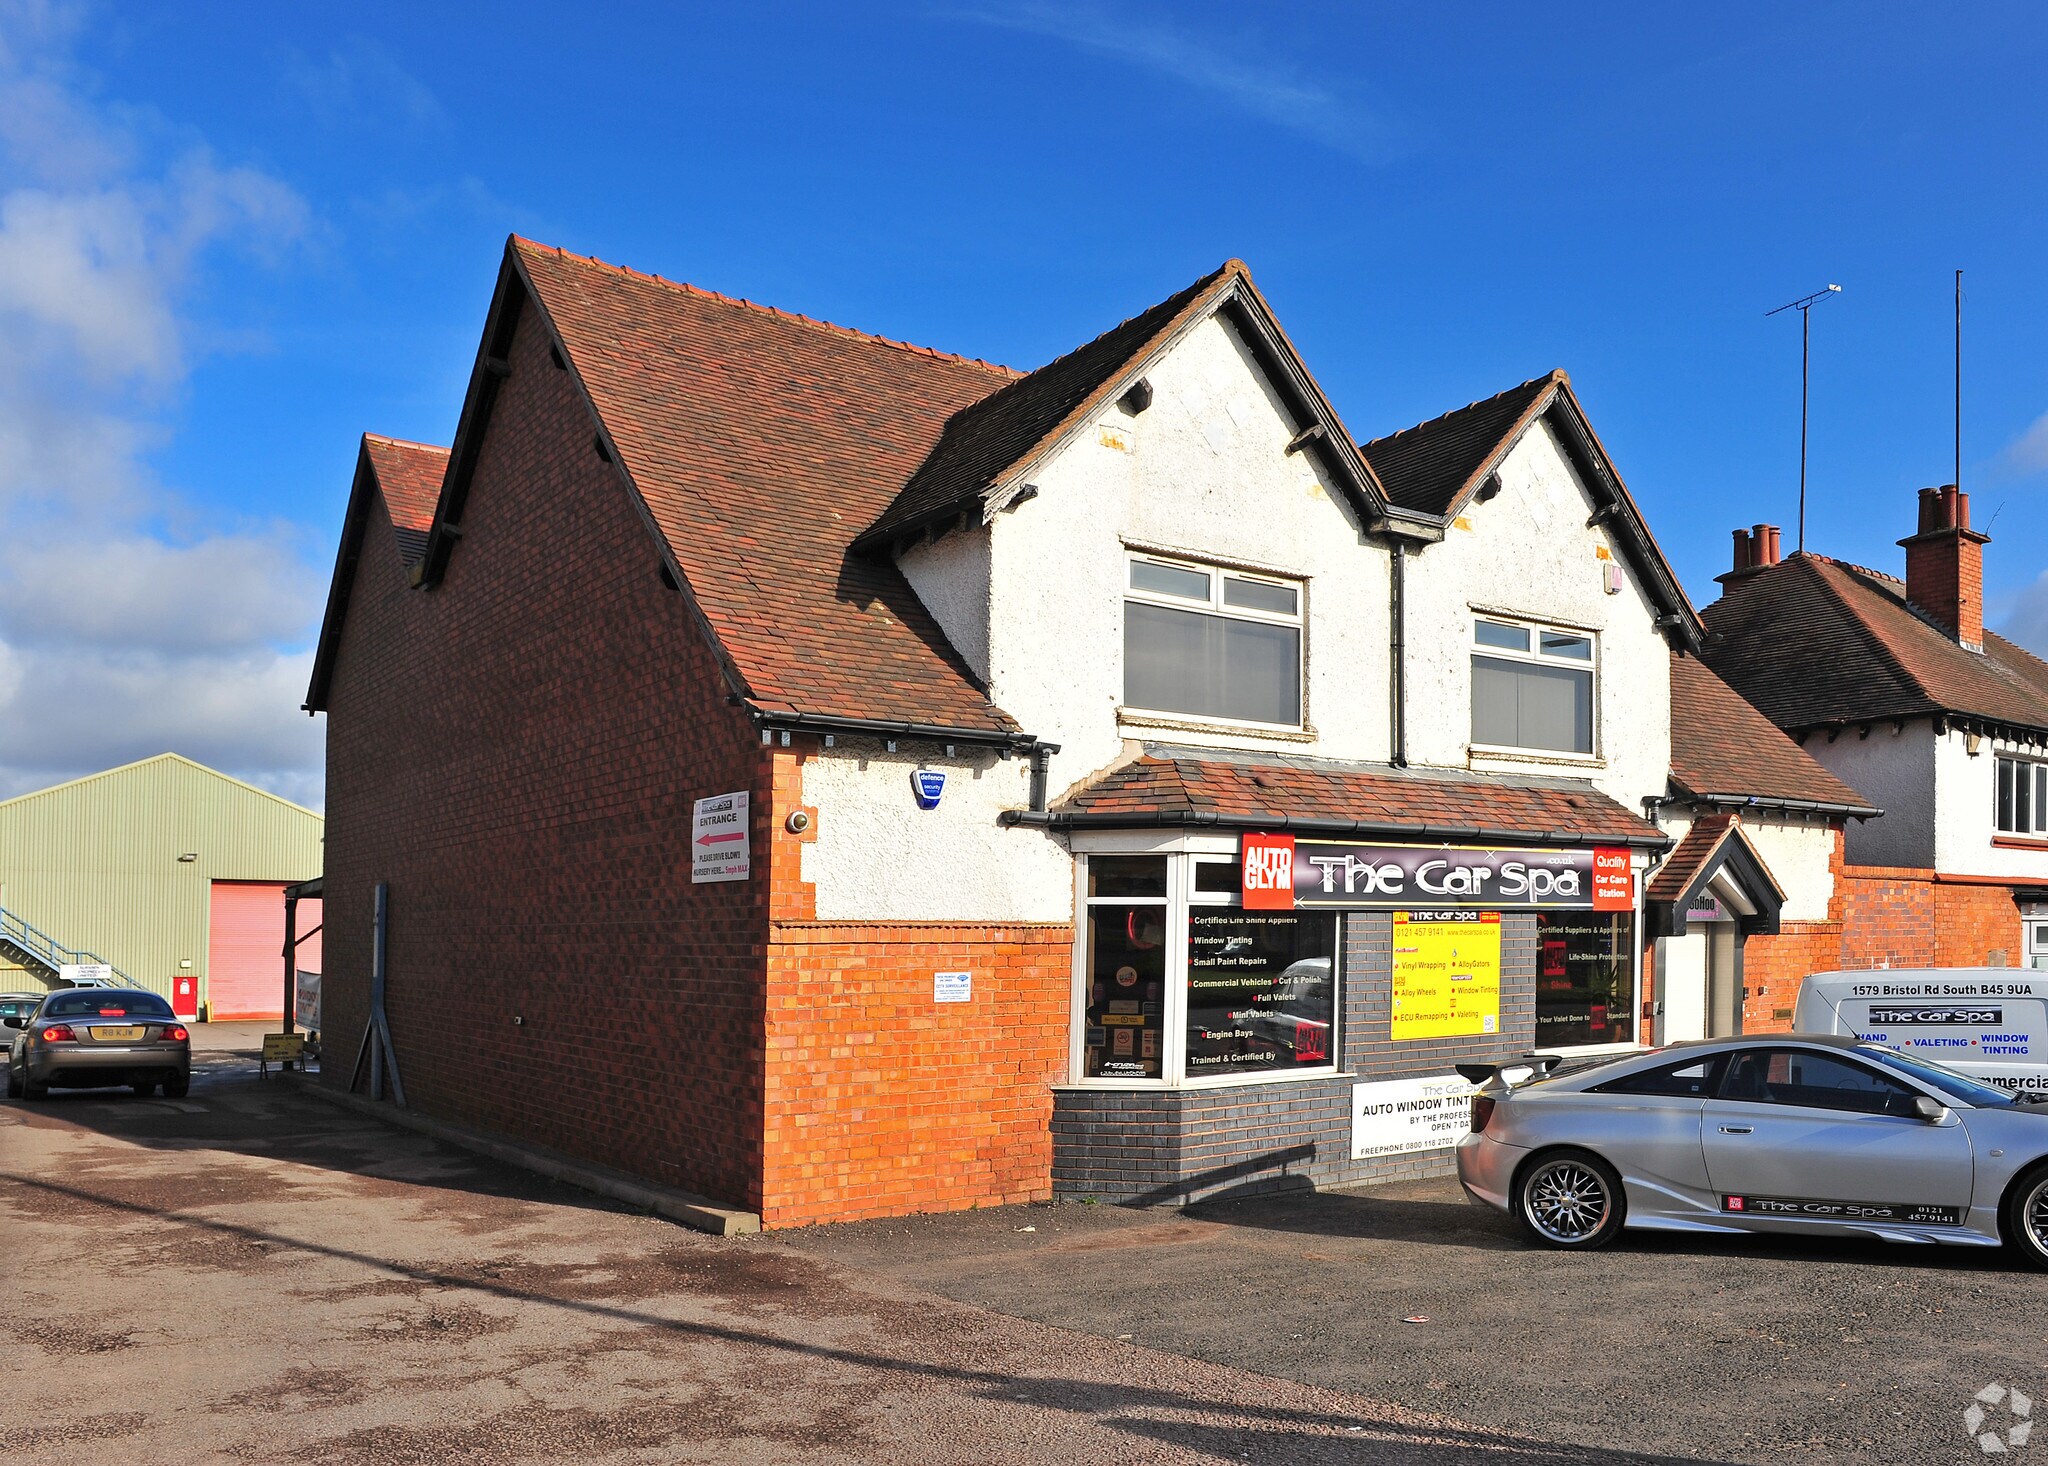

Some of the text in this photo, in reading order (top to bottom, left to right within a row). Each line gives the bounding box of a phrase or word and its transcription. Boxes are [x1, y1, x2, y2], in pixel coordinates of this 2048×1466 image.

[700, 813, 737, 826] ENTRANCE
[1245, 846, 1292, 868] AUTO
[1546, 855, 1575, 865] .co.uk
[1596, 855, 1626, 870] Quality
[1244, 867, 1291, 890] GLYM
[1309, 854, 1581, 902] The Car Spa
[1595, 874, 1628, 884] Car Care
[1598, 888, 1626, 898] Station
[1455, 912, 1477, 922] Spa
[1396, 927, 1444, 937] 0121 457 9141
[1537, 926, 1564, 934] Certified
[1565, 926, 1592, 935] Suppliers
[1194, 936, 1253, 945] Window Tinting
[1193, 958, 1216, 966] Small
[1239, 957, 1267, 966] Repairs
[1401, 961, 1446, 970] Vinyl Wrapping
[1193, 978, 1272, 988] Commercial Vehicles
[1279, 977, 1292, 985] Cut
[1300, 976, 1322, 984] Polish
[1401, 988, 1437, 997] Alloy Wheels
[1480, 986, 1498, 994] Tinting
[1852, 984, 2032, 995] 1579 Bristol Rd South B45 9UA
[1257, 993, 1296, 1002] Full Valets
[1232, 1010, 1274, 1019] Mini Valets
[1400, 1013, 1448, 1022] ECU Remapping
[1457, 1010, 1479, 1018] Valeting
[1875, 1010, 1995, 1024] The Car Spa
[1540, 1016, 1553, 1024] Your
[1206, 1029, 1254, 1040] Engine Bays
[1981, 1034, 2029, 1042] WINDOW
[1914, 1038, 1968, 1046] VALETING
[1981, 1046, 2029, 1054] TINTING
[1191, 1056, 1221, 1065] Trained
[1231, 1053, 1264, 1062] Certified
[1266, 1052, 1276, 1061] By
[1422, 1086, 1443, 1096] The
[1445, 1084, 1464, 1094] Car
[1363, 1095, 1470, 1116] AUTO WINDOW TINT
[1410, 1110, 1471, 1124] BY THE PROFESS
[1431, 1122, 1451, 1131] OPEN
[1460, 1120, 1471, 1128] DA
[1360, 1137, 1454, 1156] FREEPHONE 0800 118 2702
[1756, 1200, 1893, 1217] The Car Spa
[1918, 1206, 1943, 1214] 0121
